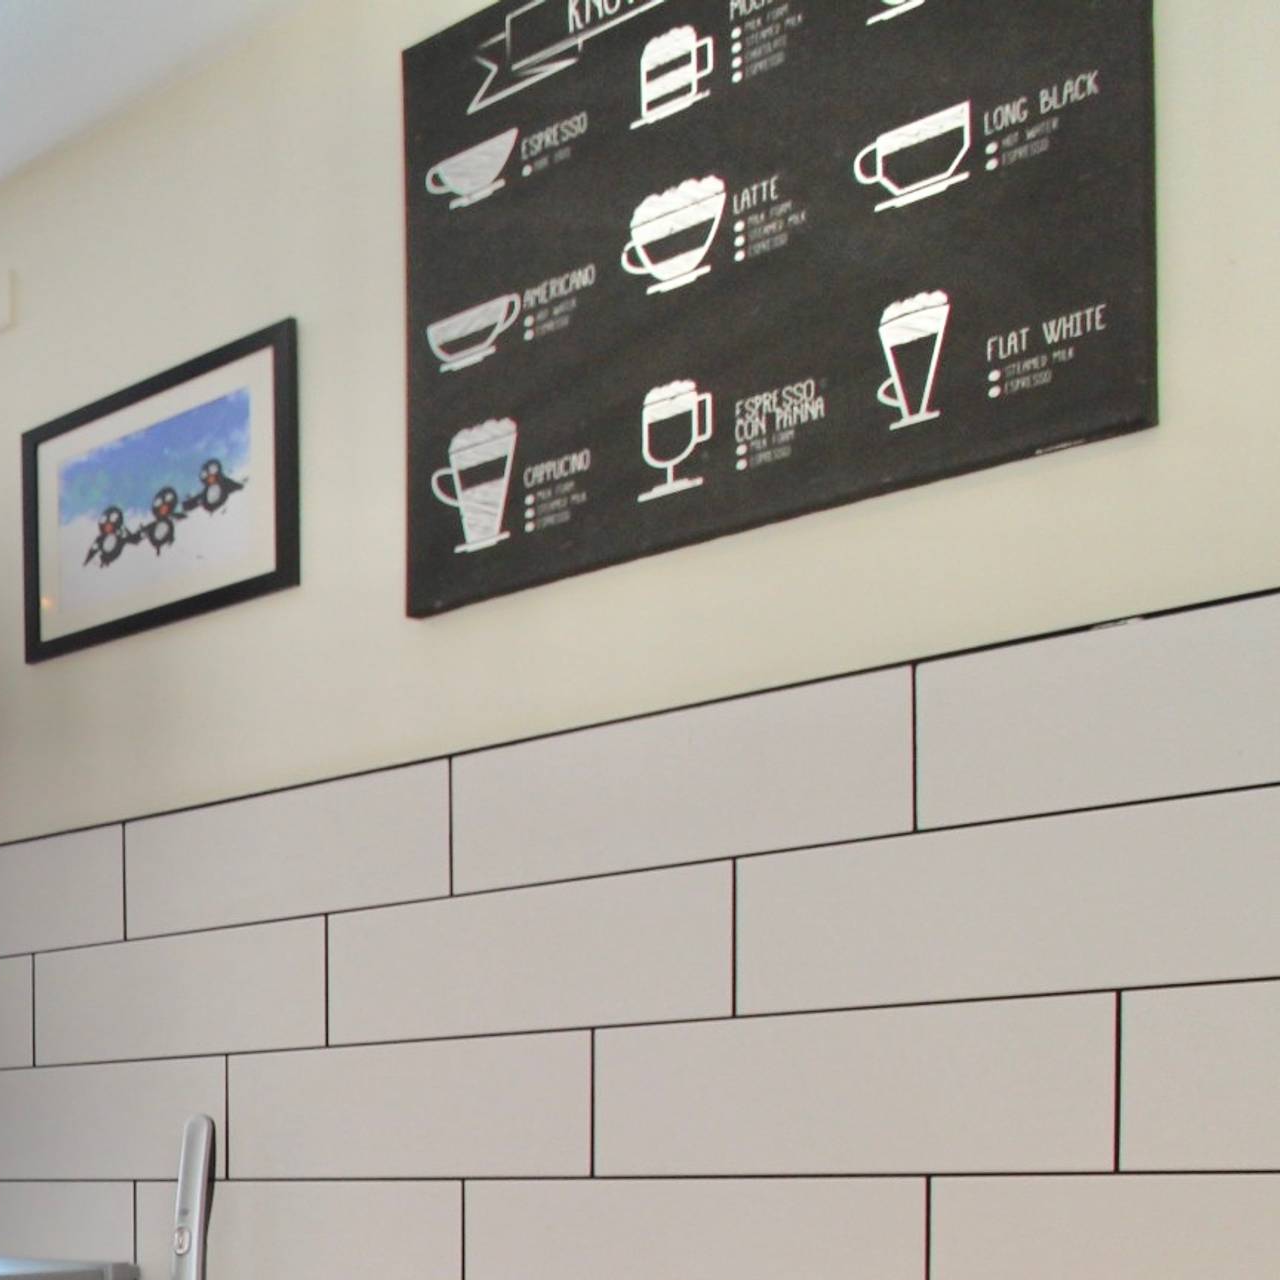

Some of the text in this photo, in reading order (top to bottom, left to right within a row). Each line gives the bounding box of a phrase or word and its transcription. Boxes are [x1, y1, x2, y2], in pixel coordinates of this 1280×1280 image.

[984, 70, 1099, 136] LONG BLACK
[521, 111, 588, 160] ESPRESSO
[733, 174, 779, 215] LATTE
[523, 263, 596, 309] AMERICANO
[987, 304, 1107, 362] FLAT WHITE
[735, 396, 825, 443] CON PANNA
[736, 379, 815, 419] ESPRESSO
